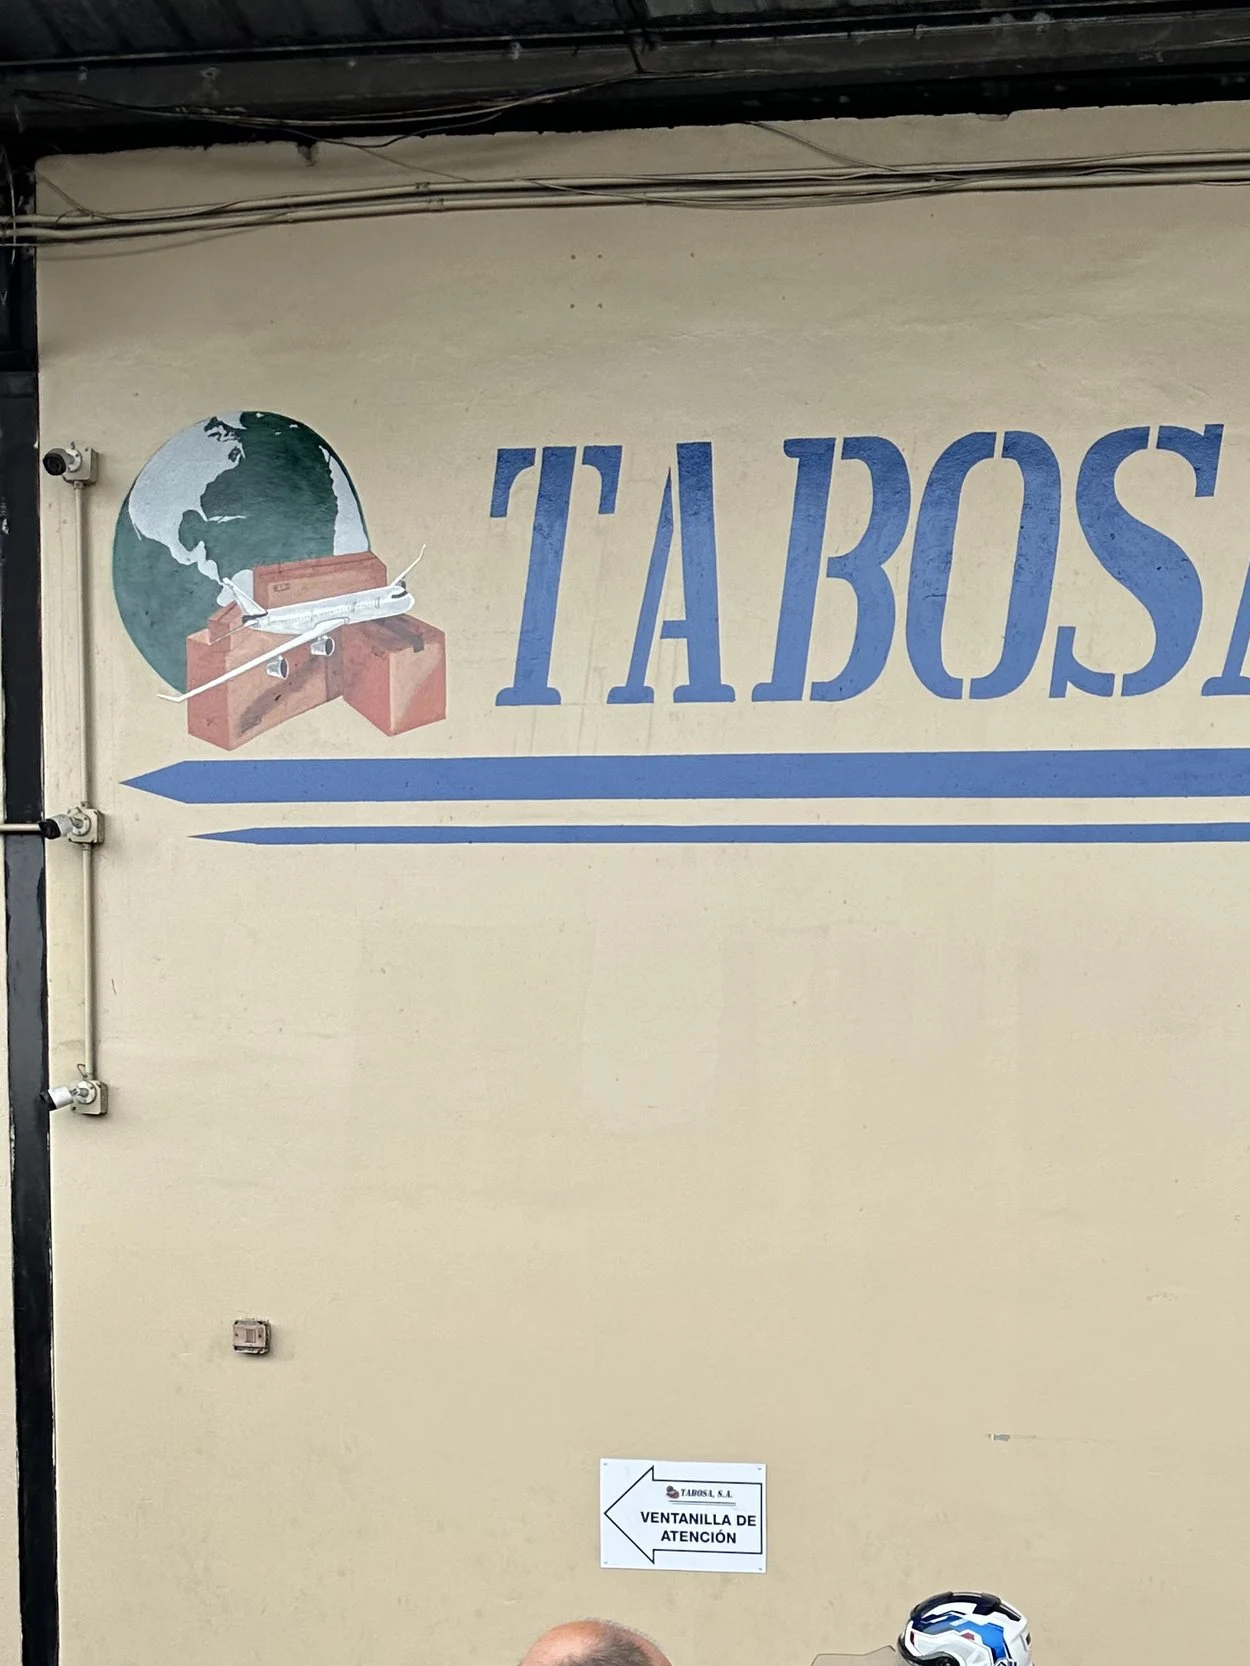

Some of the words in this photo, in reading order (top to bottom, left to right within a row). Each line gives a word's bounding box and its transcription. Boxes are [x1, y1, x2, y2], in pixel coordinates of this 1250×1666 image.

[640, 1511, 731, 1526] VENTANILLA
[736, 1514, 757, 1527] DE
[660, 1529, 737, 1544] ATENCIÓN
